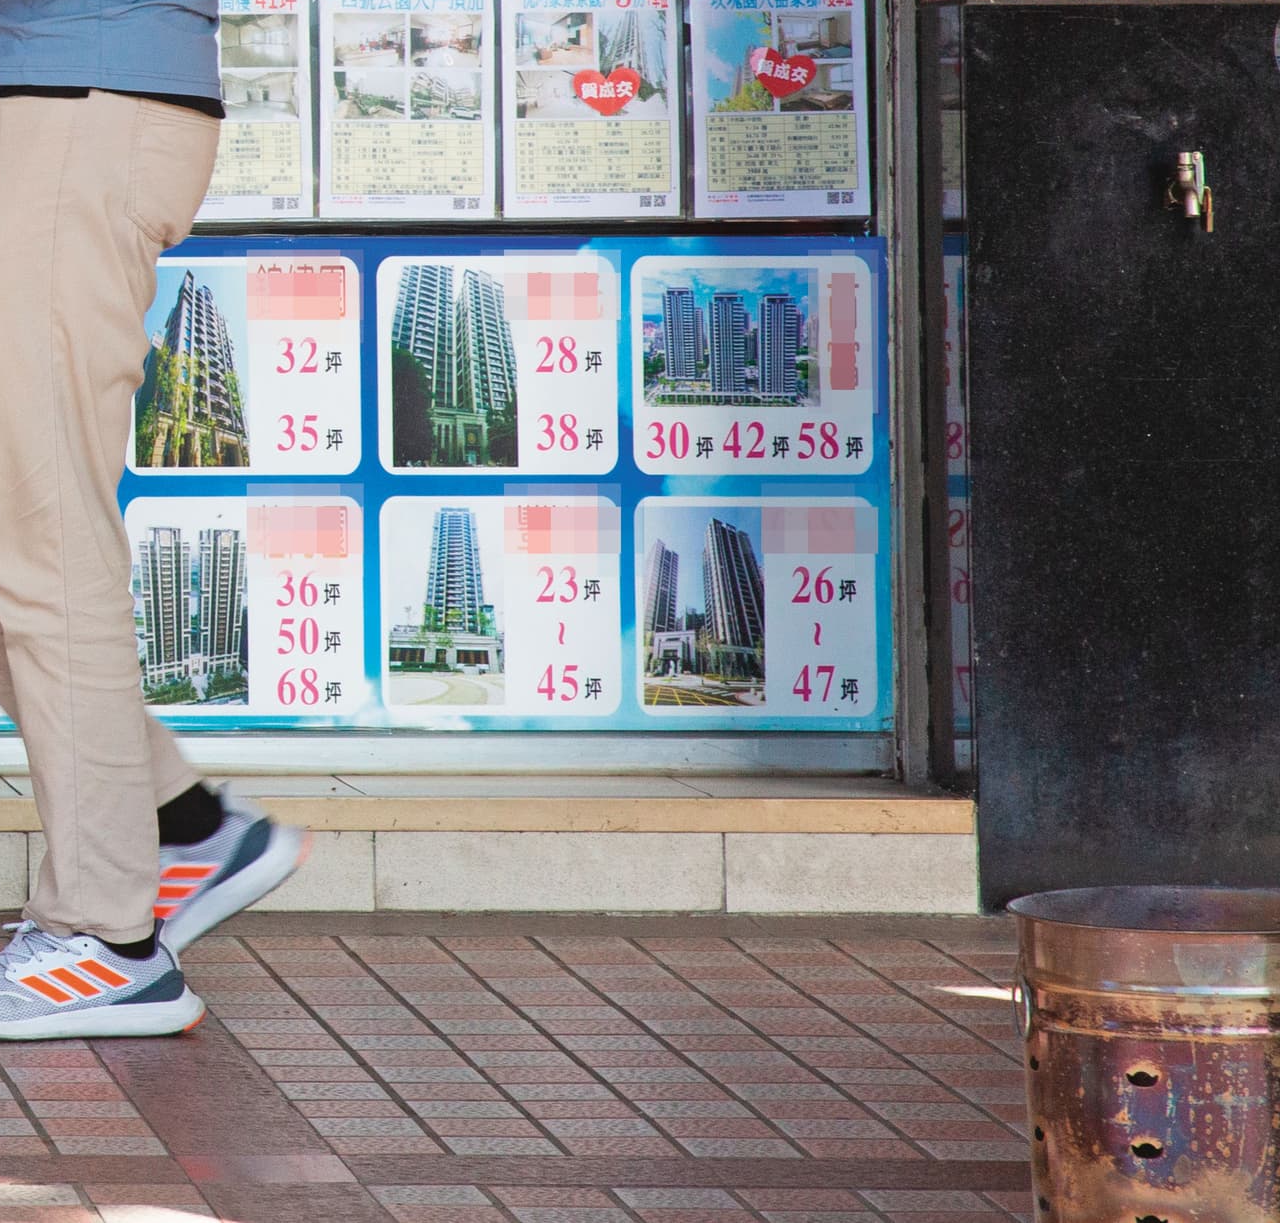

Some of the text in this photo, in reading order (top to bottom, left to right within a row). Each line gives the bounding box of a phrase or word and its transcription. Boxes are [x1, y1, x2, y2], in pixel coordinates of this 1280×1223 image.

[581, 80, 633, 99] 賀成交
[757, 58, 809, 85] 賀成交
[275, 336, 343, 374] 32坪
[535, 335, 603, 374] 28坪
[276, 414, 344, 452] 35坪
[536, 413, 604, 452] 38坪
[645, 421, 864, 460] 30坪 42坪 58坪
[275, 569, 342, 607] 36坪
[535, 565, 602, 604] 23坪
[791, 565, 857, 604] 26坪
[276, 617, 343, 655] 50坪
[276, 667, 343, 706] 68坪
[536, 663, 603, 703] 45坪
[791, 664, 859, 703] 47坪
